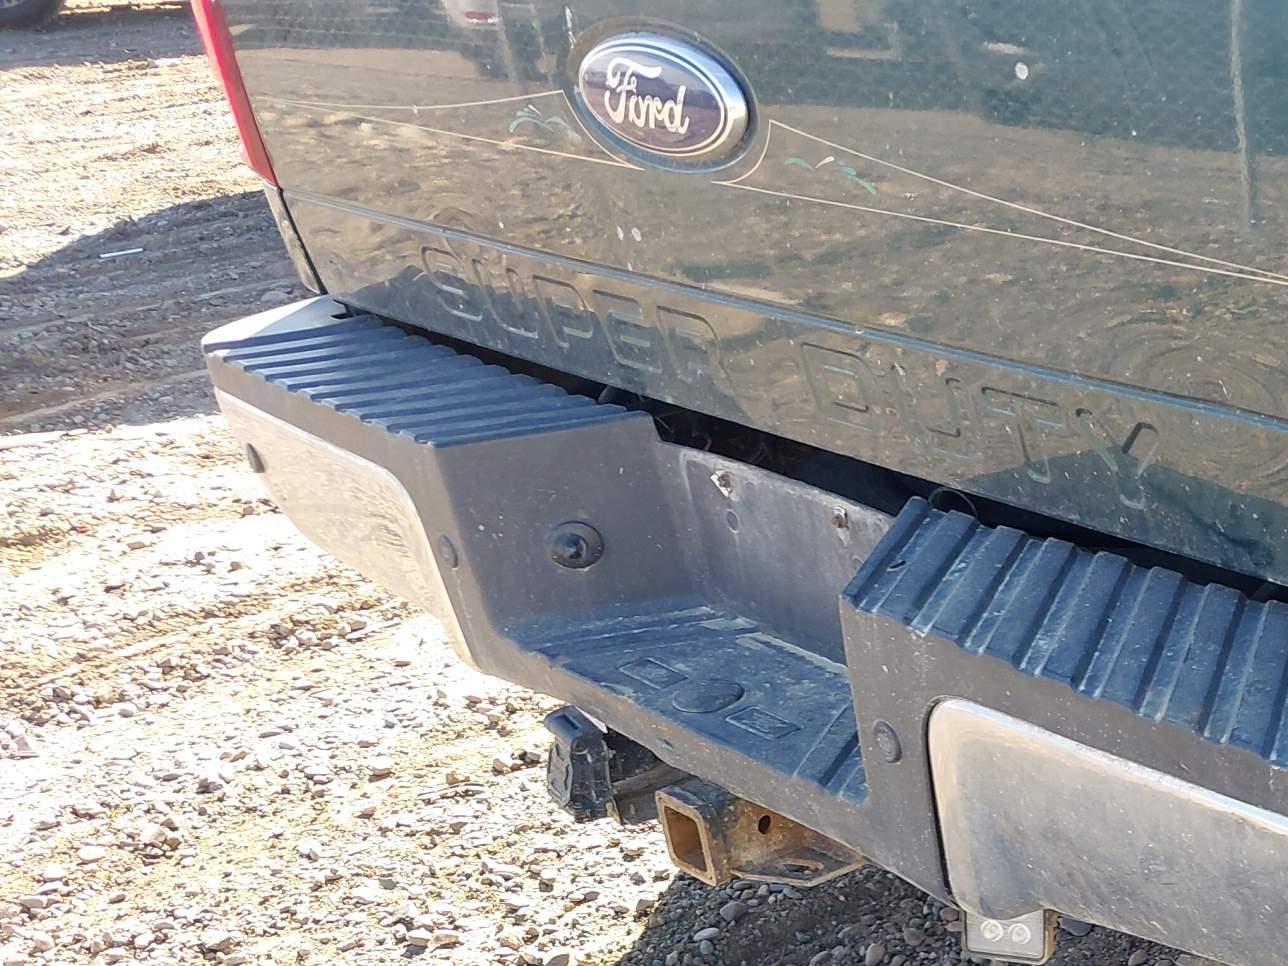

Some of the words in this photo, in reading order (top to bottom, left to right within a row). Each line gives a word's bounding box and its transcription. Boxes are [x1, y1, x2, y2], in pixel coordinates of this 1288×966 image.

[605, 57, 689, 134] Ford
[420, 246, 737, 396] SUPER
[800, 342, 1158, 510] DUTY
